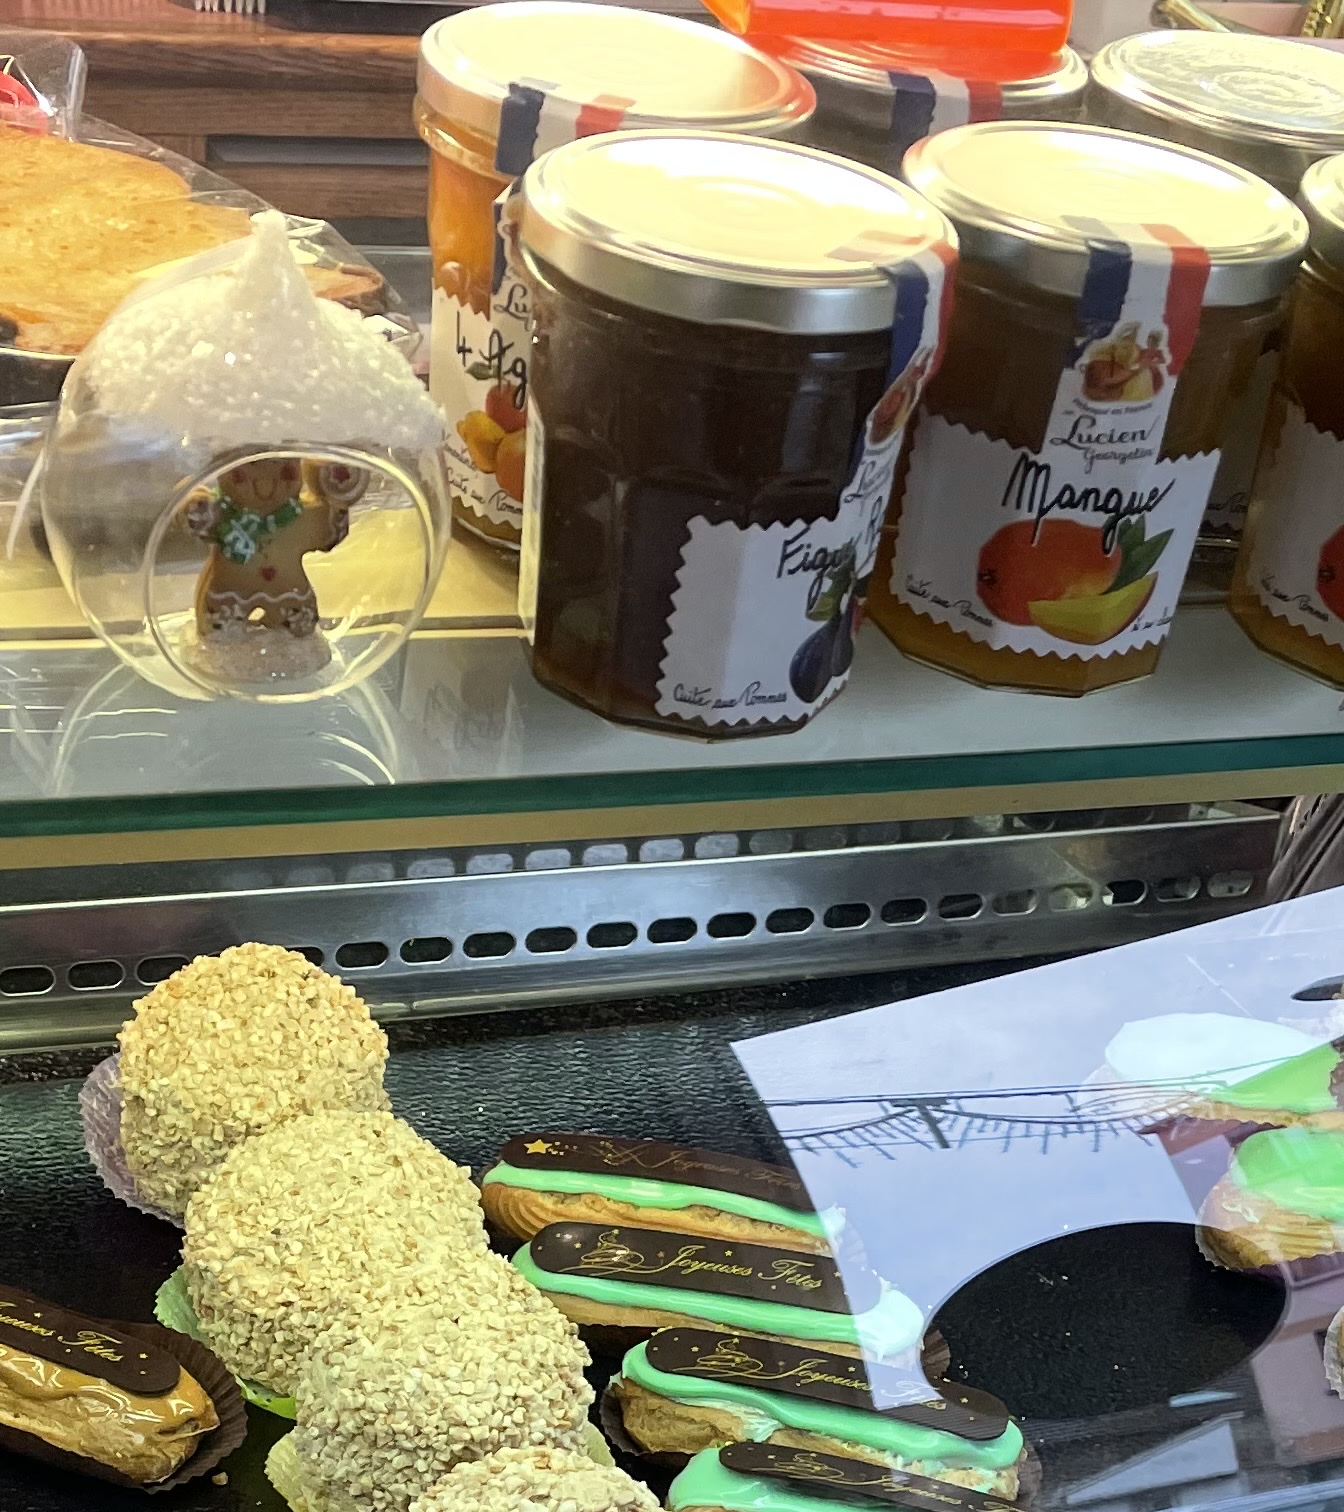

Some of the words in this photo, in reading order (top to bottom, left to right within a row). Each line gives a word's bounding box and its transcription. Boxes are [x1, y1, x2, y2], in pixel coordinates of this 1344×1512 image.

[1049, 414, 1160, 451] Lucien
[1001, 451, 1176, 556] Mangue
[662, 1245, 753, 1276] Joyeuses
